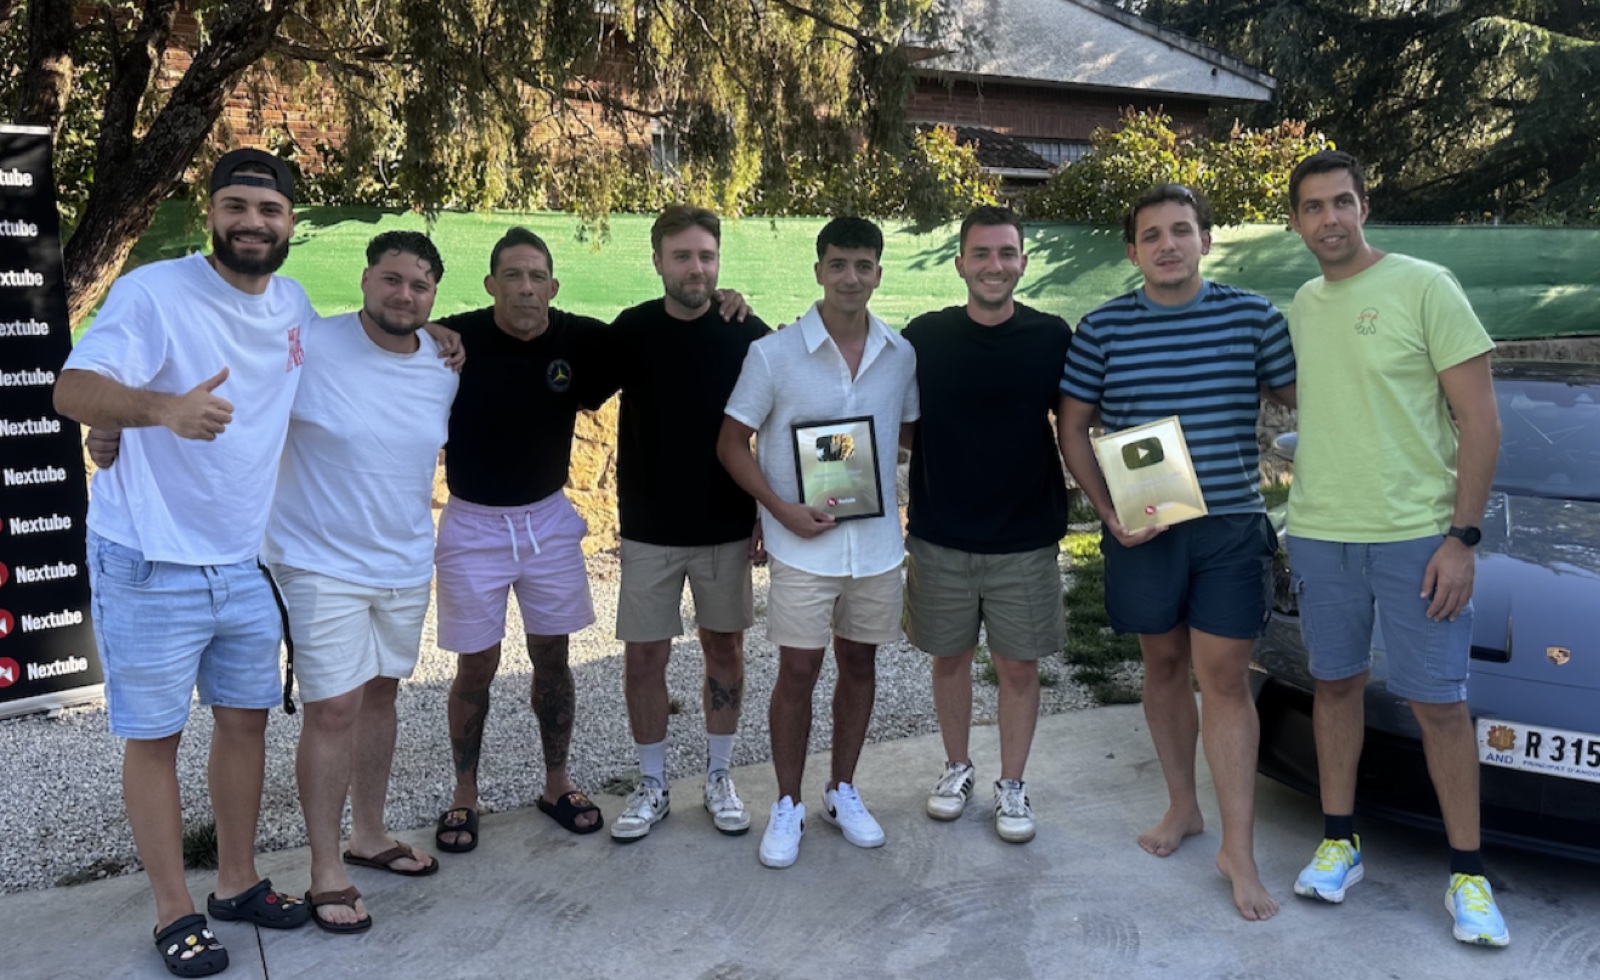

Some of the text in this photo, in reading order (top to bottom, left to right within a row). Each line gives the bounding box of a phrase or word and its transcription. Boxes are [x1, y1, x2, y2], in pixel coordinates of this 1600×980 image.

[0, 368, 55, 387] extube
[0, 417, 60, 437] Nextube
[4, 466, 66, 486] Nextube
[10, 514, 72, 535] Nextube
[16, 561, 77, 584] Nextube
[21, 609, 83, 632] Nextube
[27, 656, 88, 680] Nextube
[1485, 752, 1514, 764] AND
[1525, 731, 1600, 768] R 315
[1523, 760, 1565, 772] PRINCIPAT
